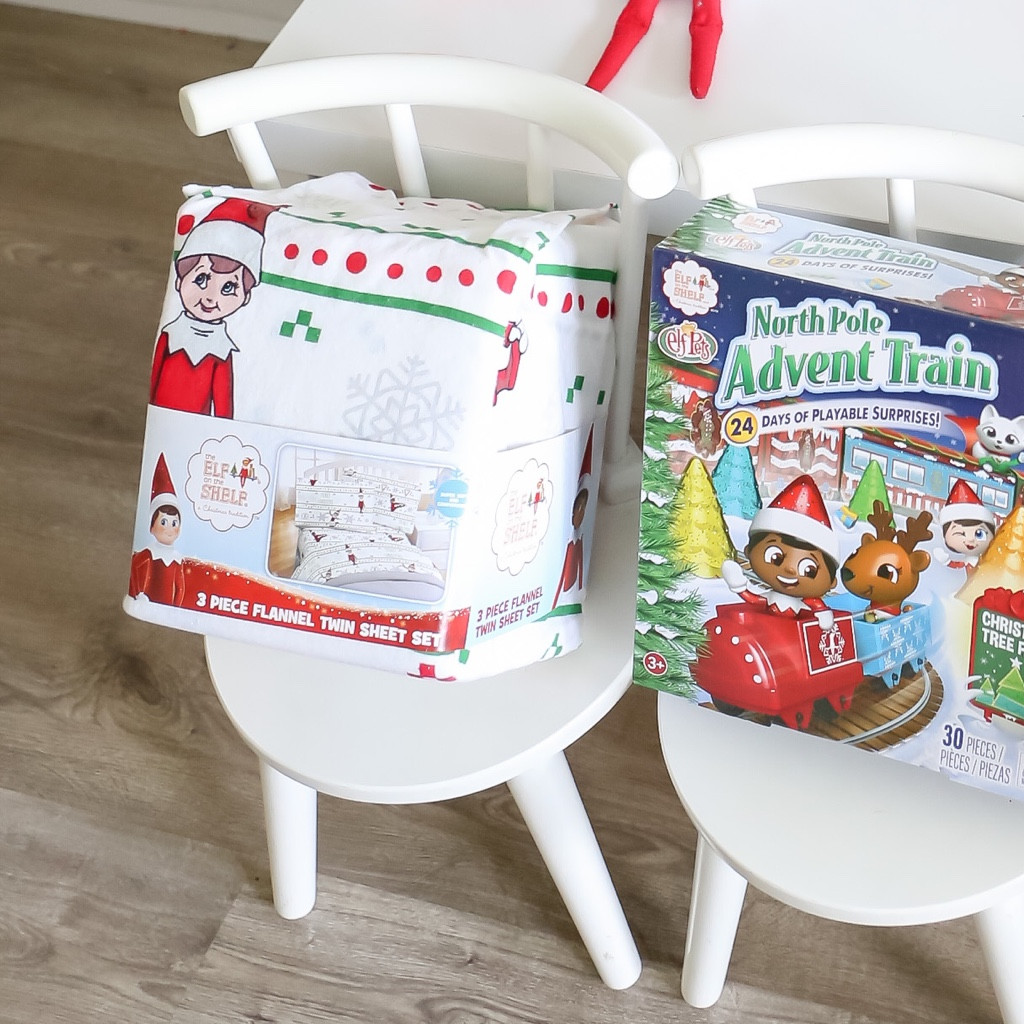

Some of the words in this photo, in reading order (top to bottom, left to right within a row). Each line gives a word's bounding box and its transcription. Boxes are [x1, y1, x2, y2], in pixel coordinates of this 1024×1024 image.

[782, 241, 870, 259] Advent
[877, 249, 935, 269] Train
[809, 233, 852, 245] North
[853, 238, 883, 249] Pole
[775, 258, 796, 266] 24
[802, 261, 836, 269] DAYS
[839, 263, 859, 271] OF
[860, 264, 934, 280] SURPRISES!
[752, 302, 826, 338] North
[830, 305, 885, 336] Pole
[688, 329, 711, 358] Pets
[724, 340, 875, 401] Advent
[884, 337, 992, 394] Train
[730, 417, 754, 437] 24
[762, 411, 792, 428] DAYS
[794, 411, 809, 424] OF
[812, 407, 869, 423] PLAYABLE
[872, 404, 941, 428] SURPRISES!
[204, 460, 230, 479] ELF
[201, 484, 247, 506] SHELF
[477, 610, 483, 622] 3
[485, 599, 509, 619] PIECE
[511, 586, 543, 609] FLANNEL
[196, 590, 207, 608] 3
[209, 594, 248, 618] PIECE
[252, 602, 315, 629] FLANNEL
[320, 615, 356, 637] TWIN
[359, 621, 407, 645] SHEET
[411, 629, 441, 649] SET
[475, 621, 497, 638] TWIN
[499, 609, 524, 629] SHEET
[527, 602, 540, 618] SET
[982, 628, 1015, 654] TREE
[646, 656, 666, 671] 3+
[942, 724, 964, 750] 30
[966, 737, 998, 761] PIECES
[979, 758, 1011, 784] PIEZAS
